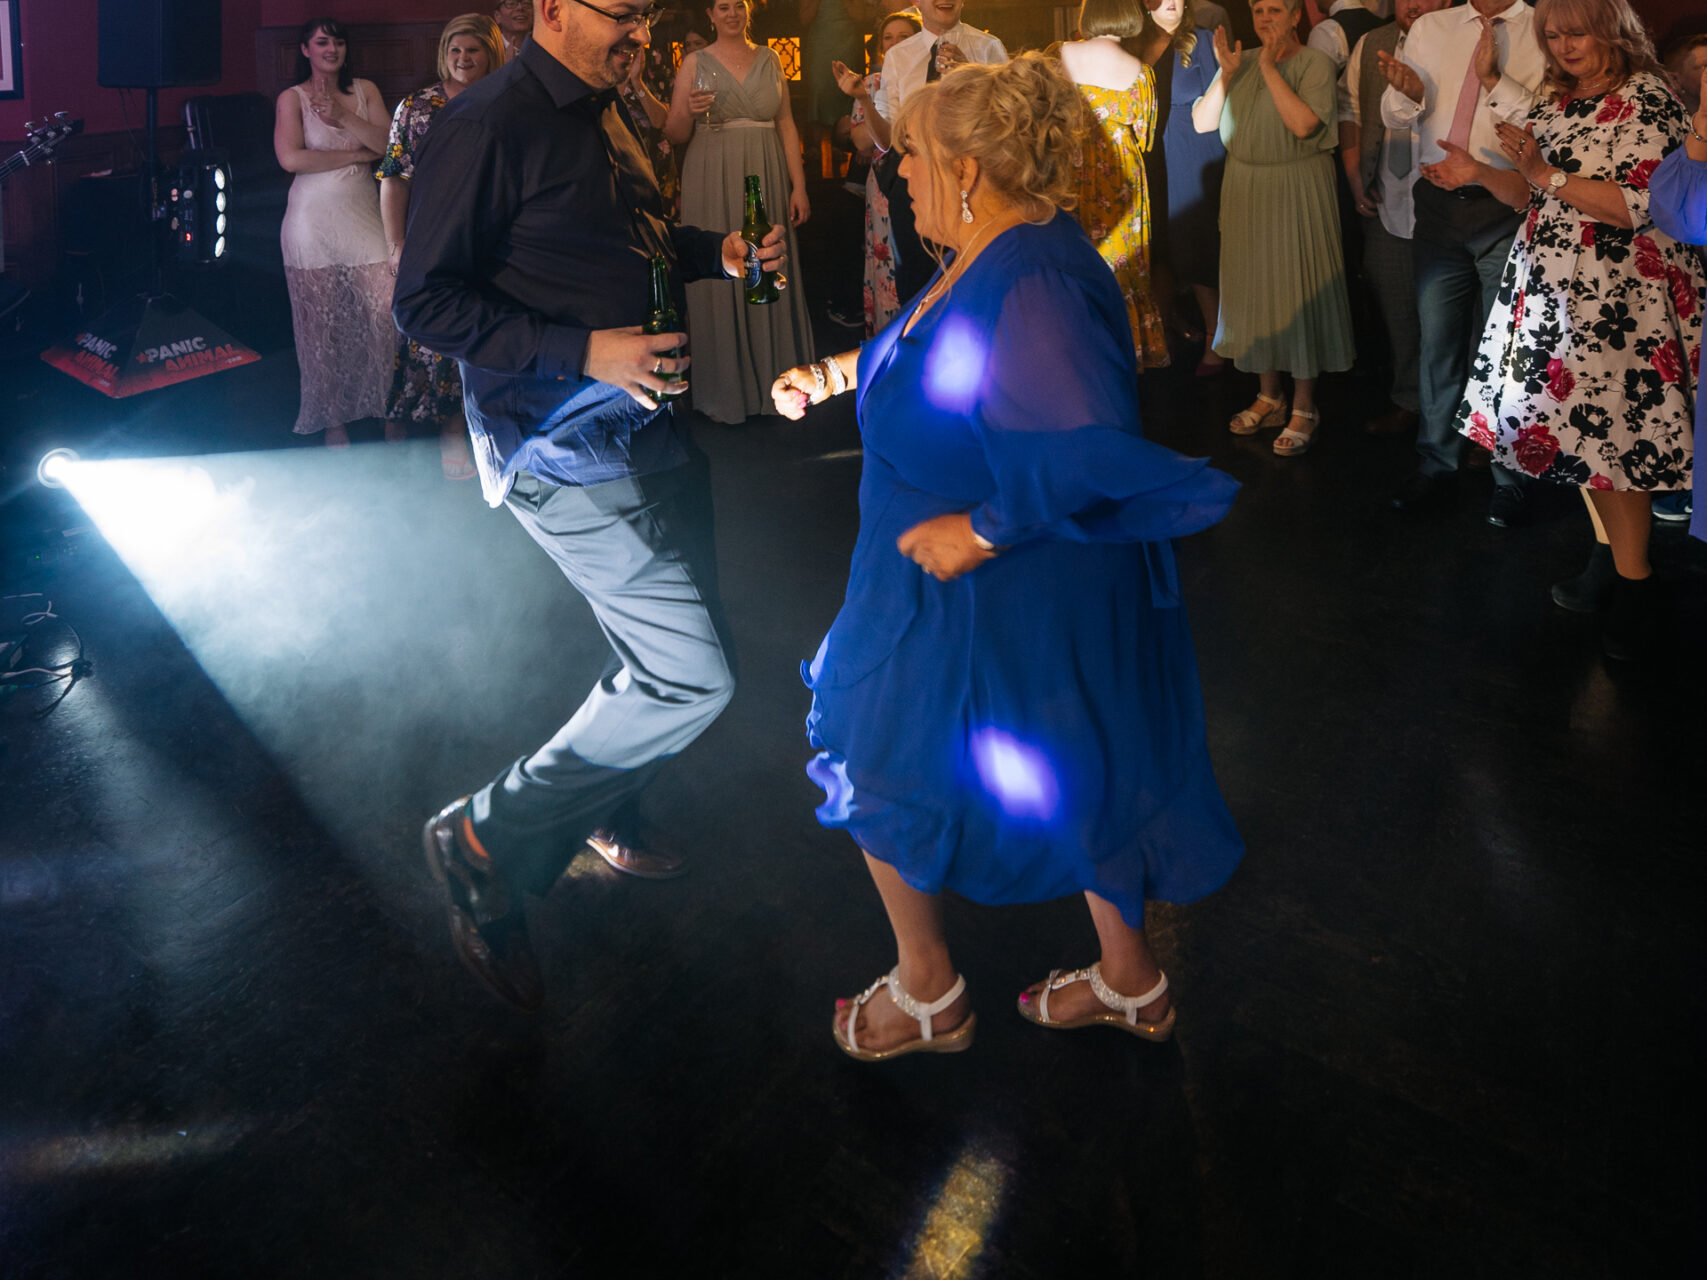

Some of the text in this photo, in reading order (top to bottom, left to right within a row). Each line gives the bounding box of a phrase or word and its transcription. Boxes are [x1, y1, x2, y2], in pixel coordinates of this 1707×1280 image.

[78, 333, 118, 358] PANIC
[145, 337, 206, 363] PANIC
[165, 344, 233, 370] ANIMAL
